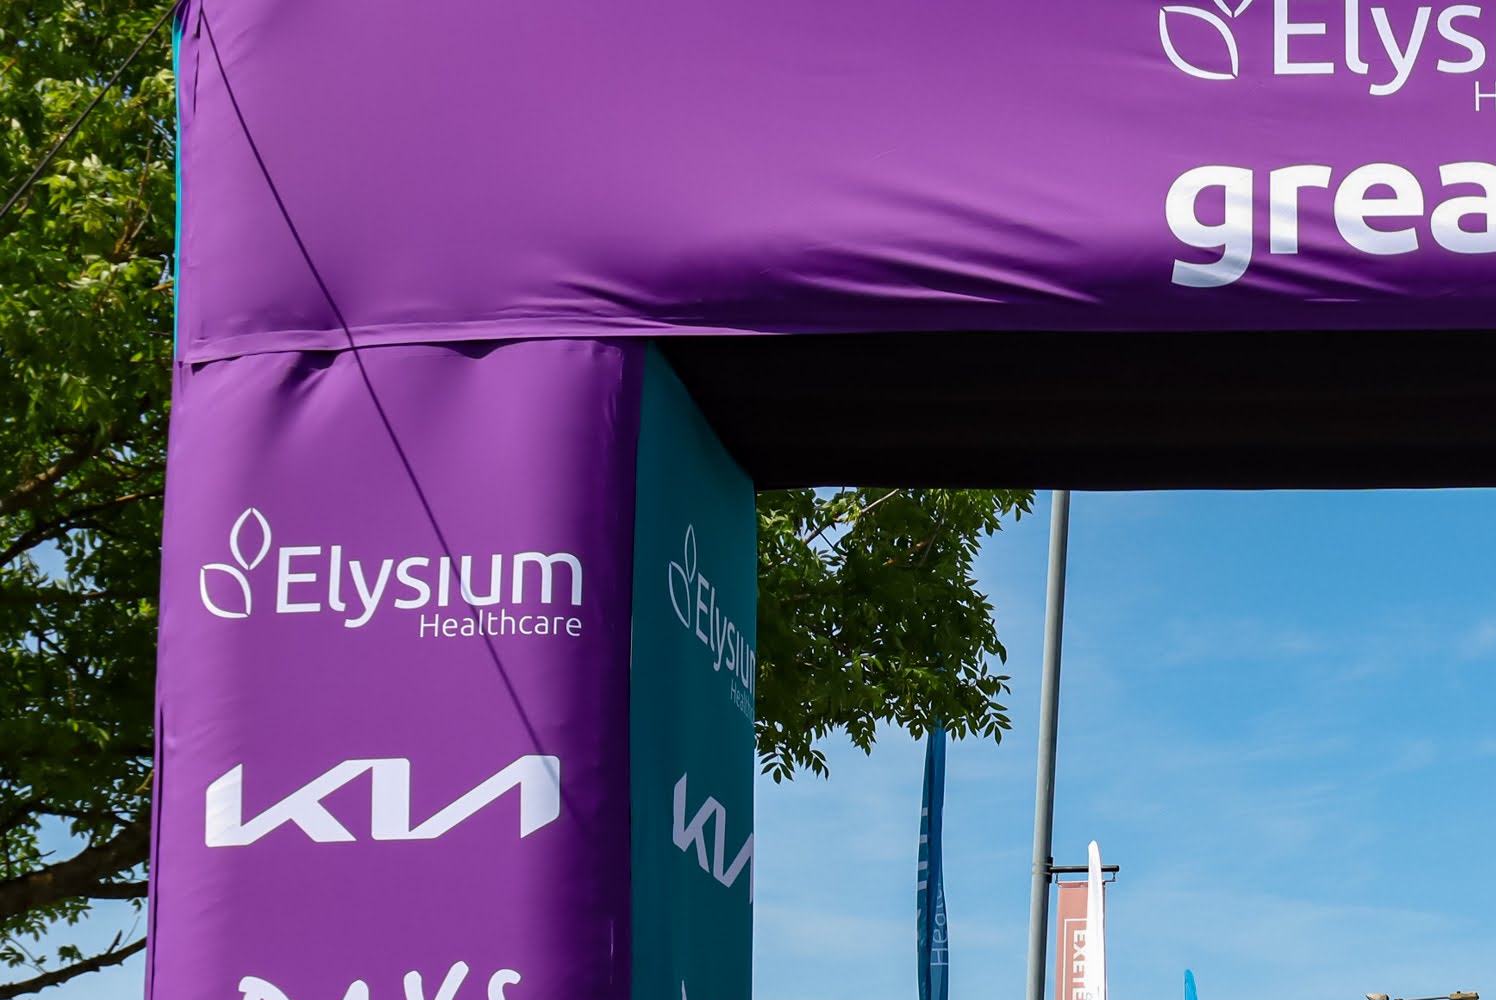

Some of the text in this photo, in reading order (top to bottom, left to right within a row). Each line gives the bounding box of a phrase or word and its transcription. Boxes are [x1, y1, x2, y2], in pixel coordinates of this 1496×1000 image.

[276, 545, 583, 629] Elysium
[419, 612, 583, 638] Healthcare
[204, 754, 561, 848] KIA
